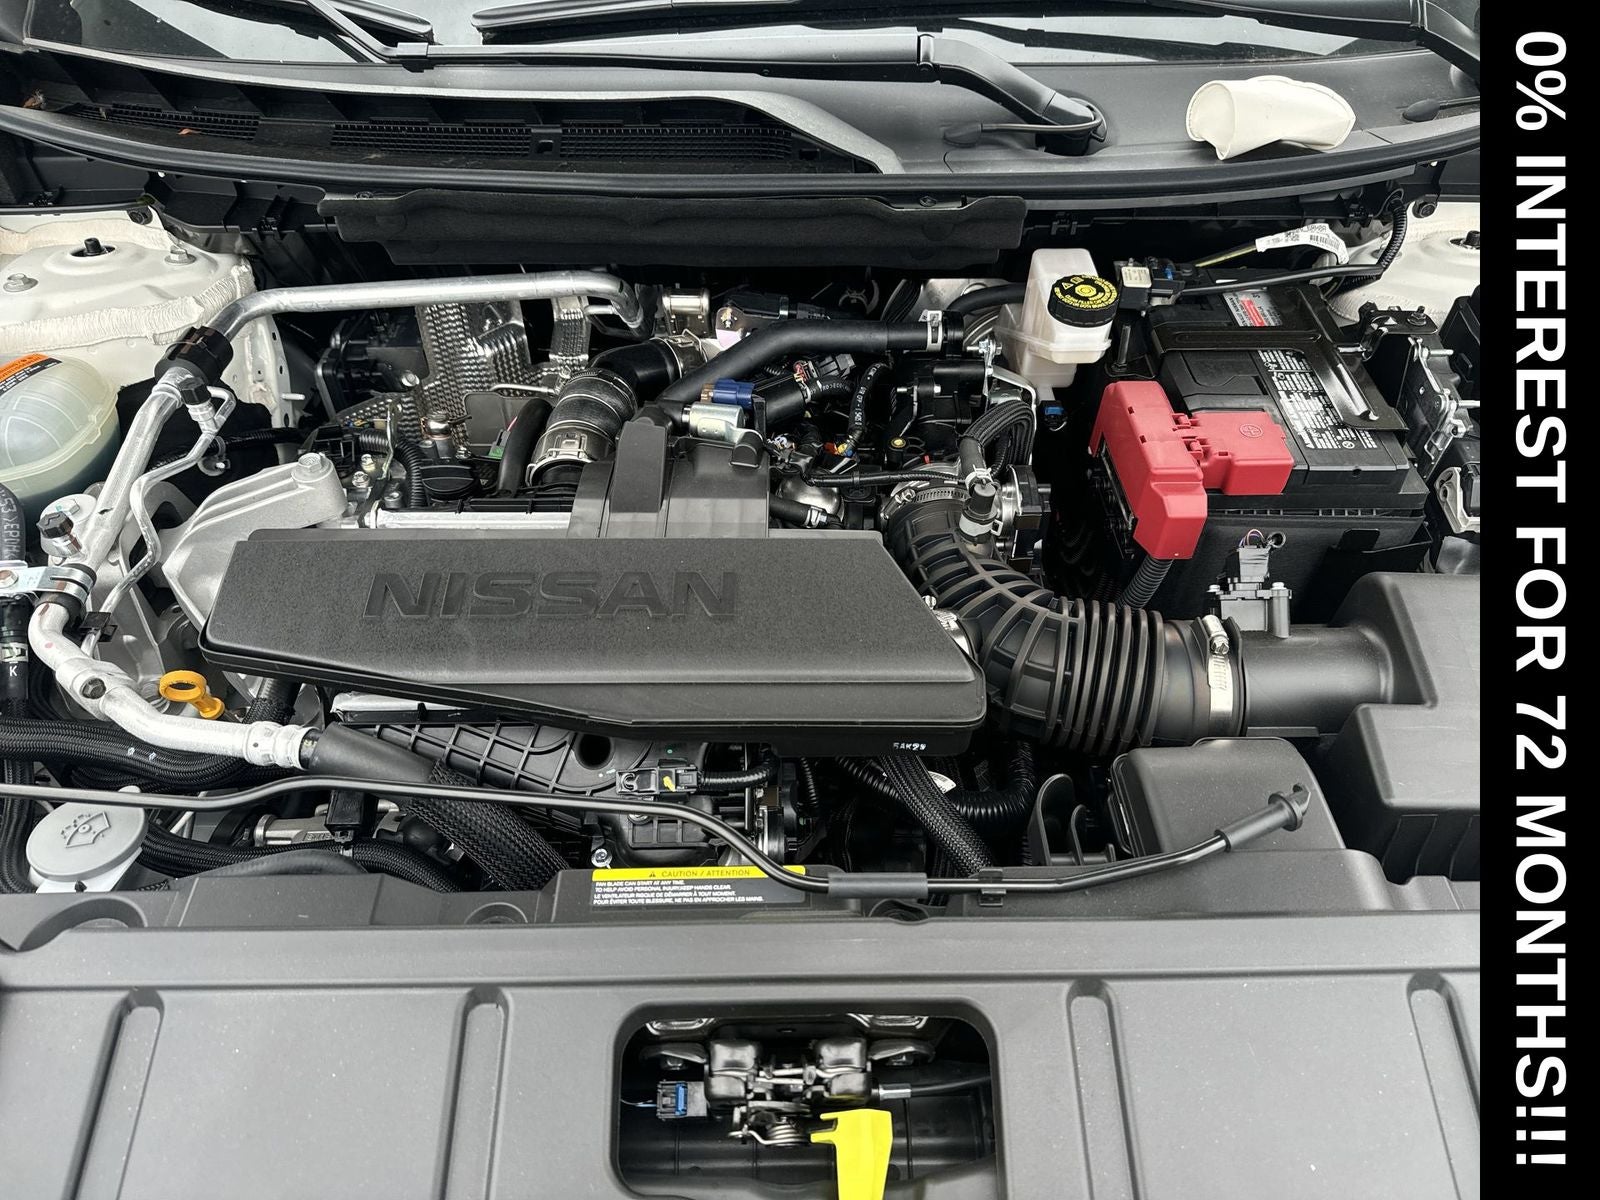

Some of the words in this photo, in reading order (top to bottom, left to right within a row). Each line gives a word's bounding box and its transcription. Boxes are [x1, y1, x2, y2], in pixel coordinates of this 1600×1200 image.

[362, 571, 736, 619] NISSAN
[9, 665, 18, 678] K
[661, 870, 698, 878] CAUTION
[706, 868, 750, 877] ATTENTION
